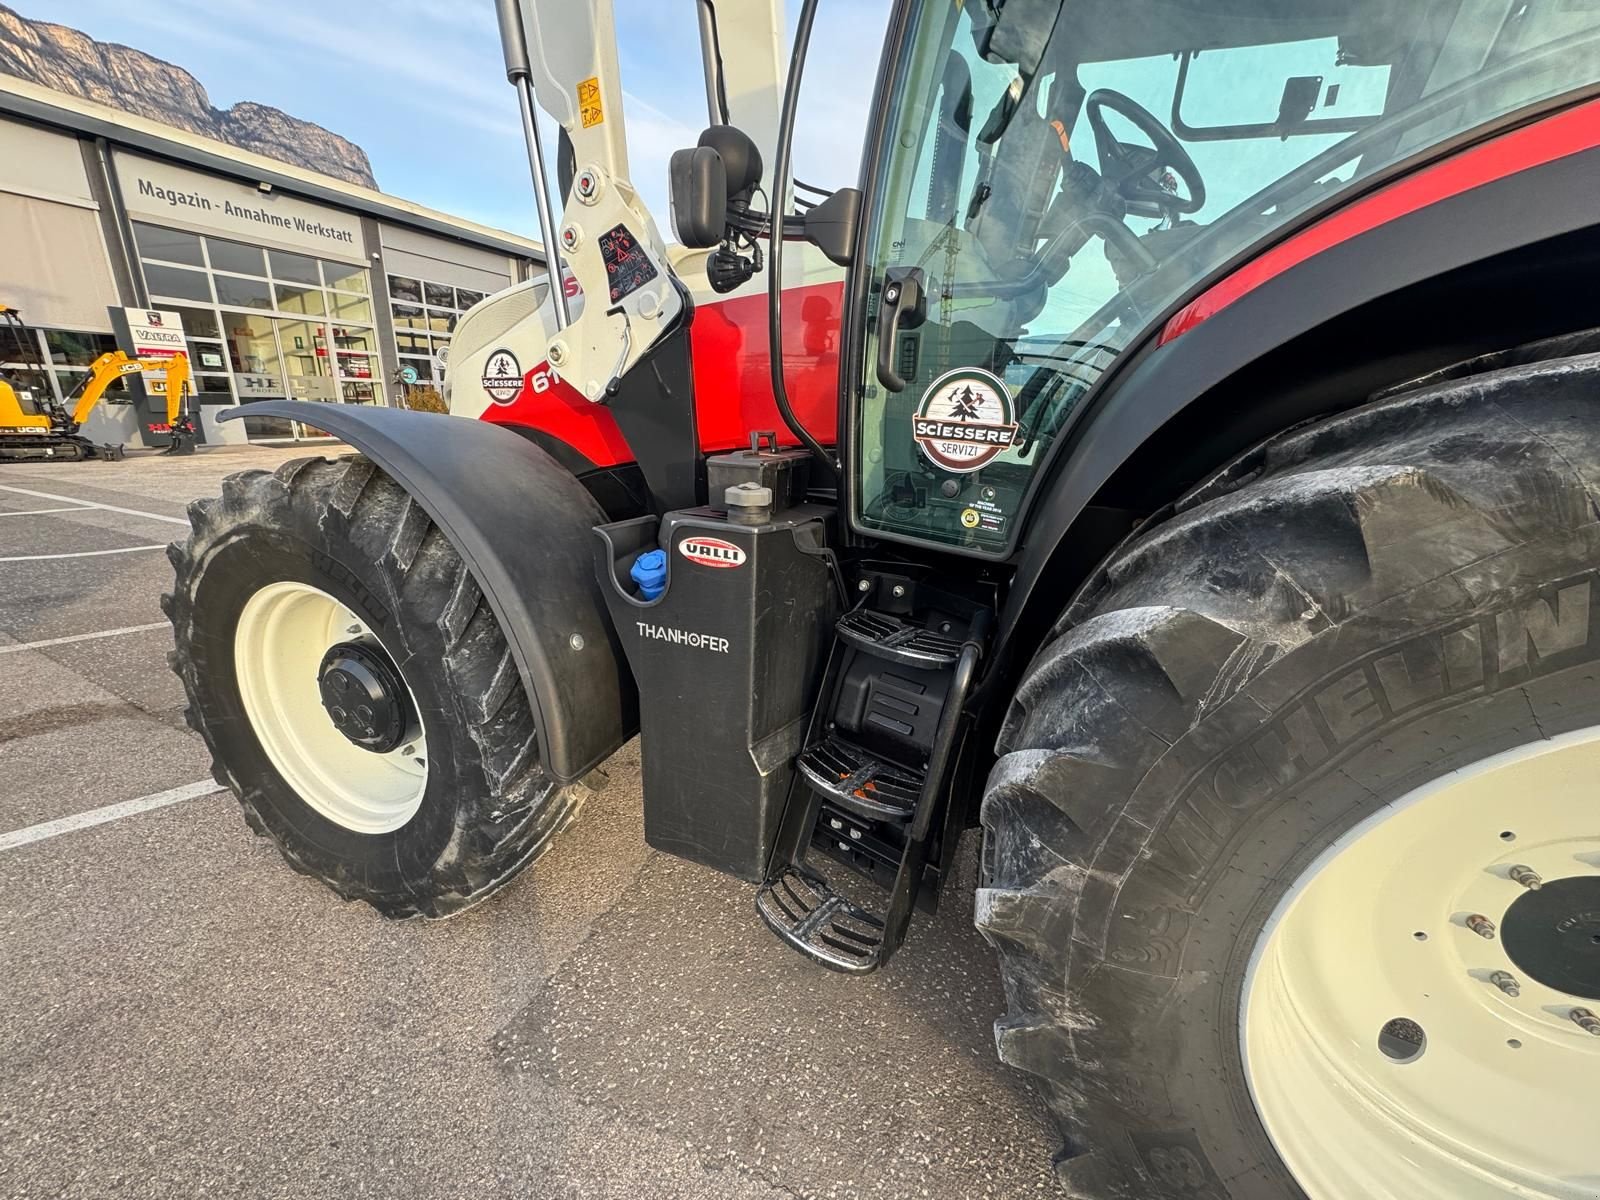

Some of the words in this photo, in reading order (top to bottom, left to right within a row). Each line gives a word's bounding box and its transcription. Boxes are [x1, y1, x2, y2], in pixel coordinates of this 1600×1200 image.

[137, 178, 211, 211] Magazin
[224, 200, 292, 230] Annahme
[293, 216, 353, 244] Werkstatt
[136, 329, 182, 343] VALTRA
[119, 362, 143, 372] JCB
[483, 379, 523, 387] SCIESSERE
[916, 421, 1013, 444] SCIESSERE
[940, 442, 978, 457] SERVIZI
[636, 621, 730, 654] THANHOFER
